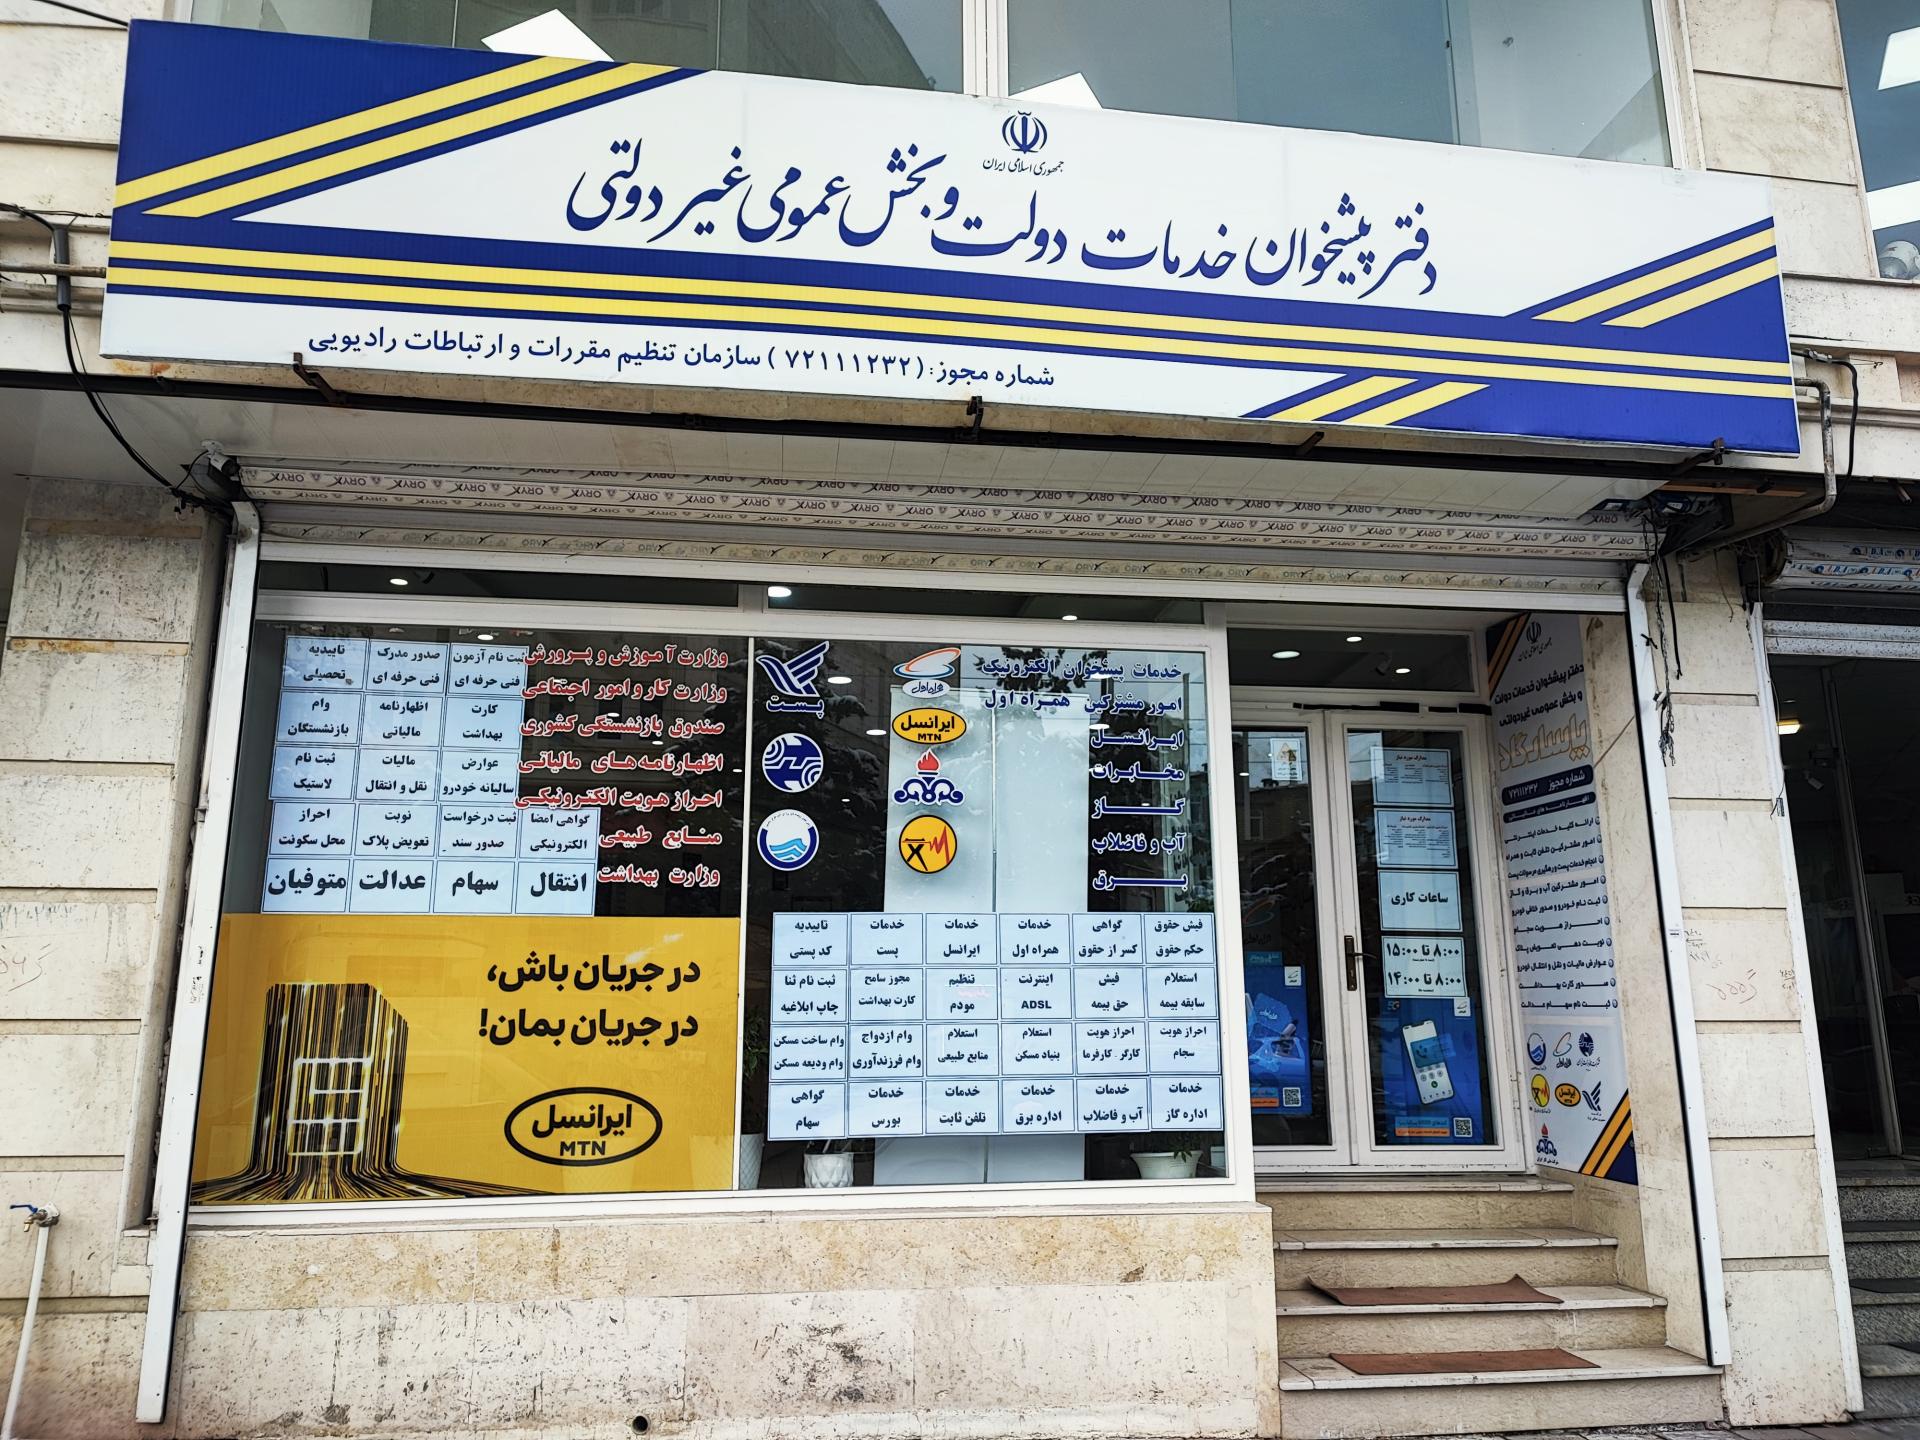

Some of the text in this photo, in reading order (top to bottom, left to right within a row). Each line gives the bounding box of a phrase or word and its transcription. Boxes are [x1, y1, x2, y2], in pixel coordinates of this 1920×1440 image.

[983, 158, 1064, 176] جمهوری اسلامی ایران
[566, 138, 1437, 299] دفتر پیشخوان خدمات دولت و بخش عمومی غیر دولتی
[308, 326, 397, 352] رادیویی
[404, 329, 502, 359] ارتباطات
[510, 341, 520, 360] و
[528, 336, 611, 365] مقررات
[618, 341, 675, 372] تنظیم
[684, 343, 761, 369] سازمان
[996, 364, 1054, 387] شماره
[524, 643, 593, 666] پرورش
[596, 650, 606, 665] و
[677, 648, 728, 668] وزارت
[982, 658, 1181, 682] خدمات پیشخوان الکترونیک
[521, 678, 727, 703] وزارت کار و امور اجتماعی
[380, 702, 428, 714] اظهارنامه
[766, 695, 824, 719] پست
[984, 690, 1182, 714] امور مشترکین همراه اول
[471, 704, 498, 716] کارت
[288, 723, 349, 737] بازنشستگان
[519, 714, 724, 738] صندوق بازنشستگی کشوری
[901, 716, 954, 732] ایرانسل
[383, 727, 421, 739] مالیاتی
[463, 728, 503, 739] بهداشت
[1091, 729, 1184, 750] ایرانسل
[518, 752, 581, 772] مالیاتی
[591, 752, 635, 773] های
[1092, 762, 1183, 783] مخابرات
[514, 787, 722, 812] احراز هویت الکترونیکی
[1091, 796, 1185, 818] گاز
[299, 809, 330, 822] احراز
[531, 814, 590, 826] گواهی امضا
[600, 825, 722, 848] منابع طبیعی
[1092, 832, 1186, 854] آب و فاضلاب
[529, 838, 587, 851] الکترونیکی
[268, 868, 347, 895] متوفیان
[359, 870, 427, 890] عدالت
[452, 871, 499, 895] سهام
[597, 864, 720, 887] وزارت بهداشت
[1092, 870, 1188, 891] برق
[531, 873, 587, 897] انتقال
[1391, 892, 1448, 906] ساعات کاری
[870, 920, 904, 930] خدمات
[945, 920, 979, 929] خدمات
[1018, 920, 1052, 930] خدمات
[1092, 920, 1122, 933] گواهی
[1154, 919, 1203, 933] فیش حقوق
[790, 946, 832, 960] کد پستی
[877, 947, 898, 960] پست
[943, 944, 980, 957] ایرانسل
[1013, 944, 1059, 958] همراه اول
[1079, 944, 1138, 958] کسر از حقوق
[1156, 944, 1204, 957] حکم حقوق
[1422, 944, 1430, 956] تا
[488, 951, 700, 992] در جریان باش،
[1424, 973, 1432, 985] تا
[1019, 973, 1053, 987] اینترنت
[1021, 1000, 1052, 1009] ADSL
[479, 1008, 699, 1046] در جریان بمان!
[868, 1087, 904, 1098] خدمات
[945, 1086, 980, 1097] خدمات
[1021, 1085, 1055, 1095] خدمات
[1095, 1084, 1130, 1095] خدمات
[1169, 1082, 1202, 1093] خدمات
[792, 1090, 825, 1104] گواهی
[532, 1104, 632, 1138] ایرانسل
[871, 1117, 901, 1128] بورس
[939, 1112, 986, 1125] تلفن ثابت
[1016, 1111, 1062, 1126] اداره برق
[1083, 1107, 1143, 1123] آب و فاضلاب
[1166, 1109, 1208, 1122] اداره گاز
[796, 1117, 820, 1130] سهام
[559, 1141, 606, 1156] MTN
